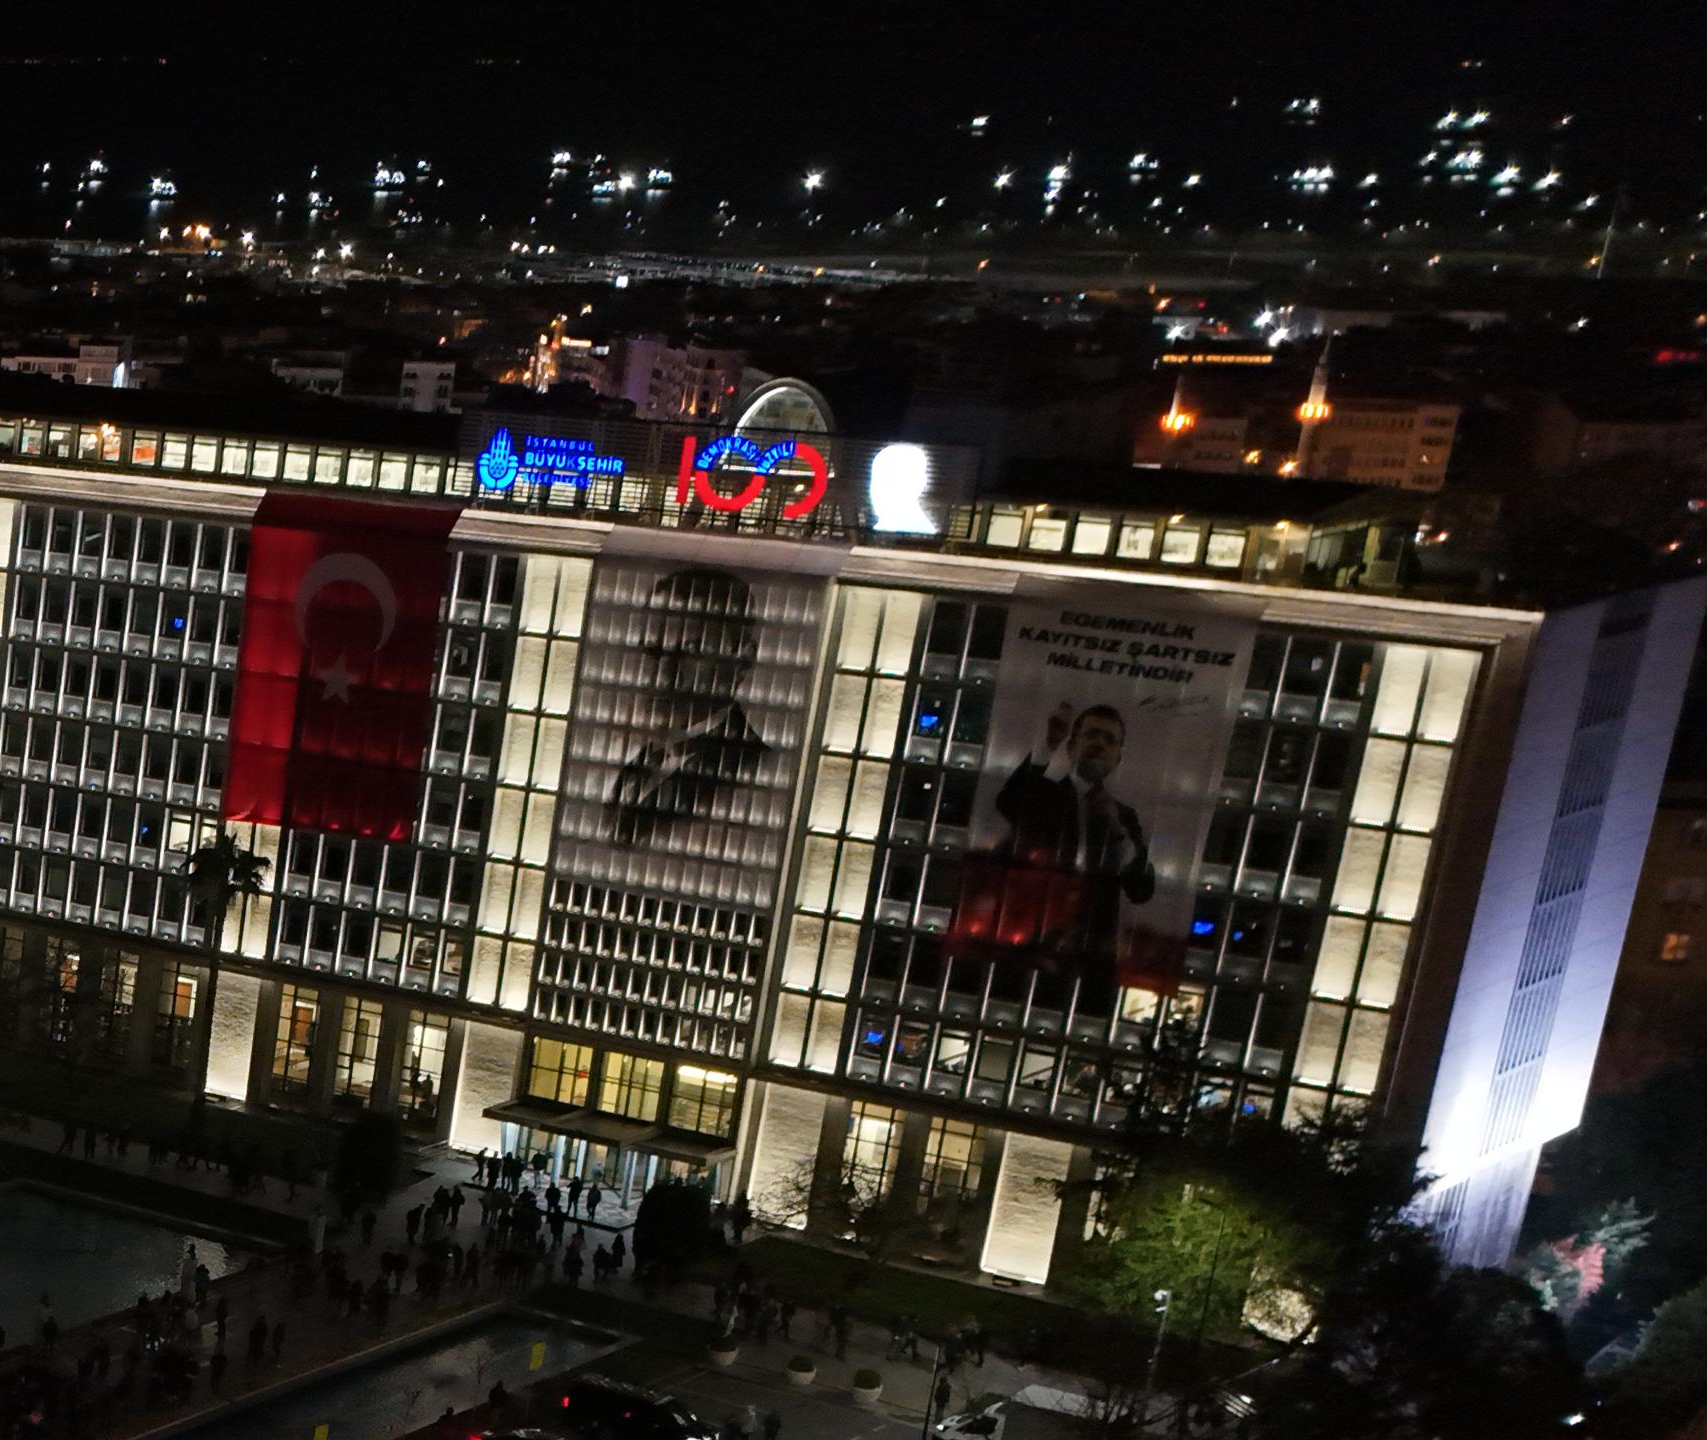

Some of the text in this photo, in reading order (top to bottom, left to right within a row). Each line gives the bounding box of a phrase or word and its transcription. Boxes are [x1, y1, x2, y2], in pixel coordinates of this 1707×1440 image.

[525, 449, 623, 473] BÜYÜKŞEHİR
[1058, 610, 1197, 641] EGEMENLİK
[1018, 626, 1237, 668] KAYITSIZ ŞARTSIZ
[1046, 651, 1195, 684] MİLLETİNDİR
